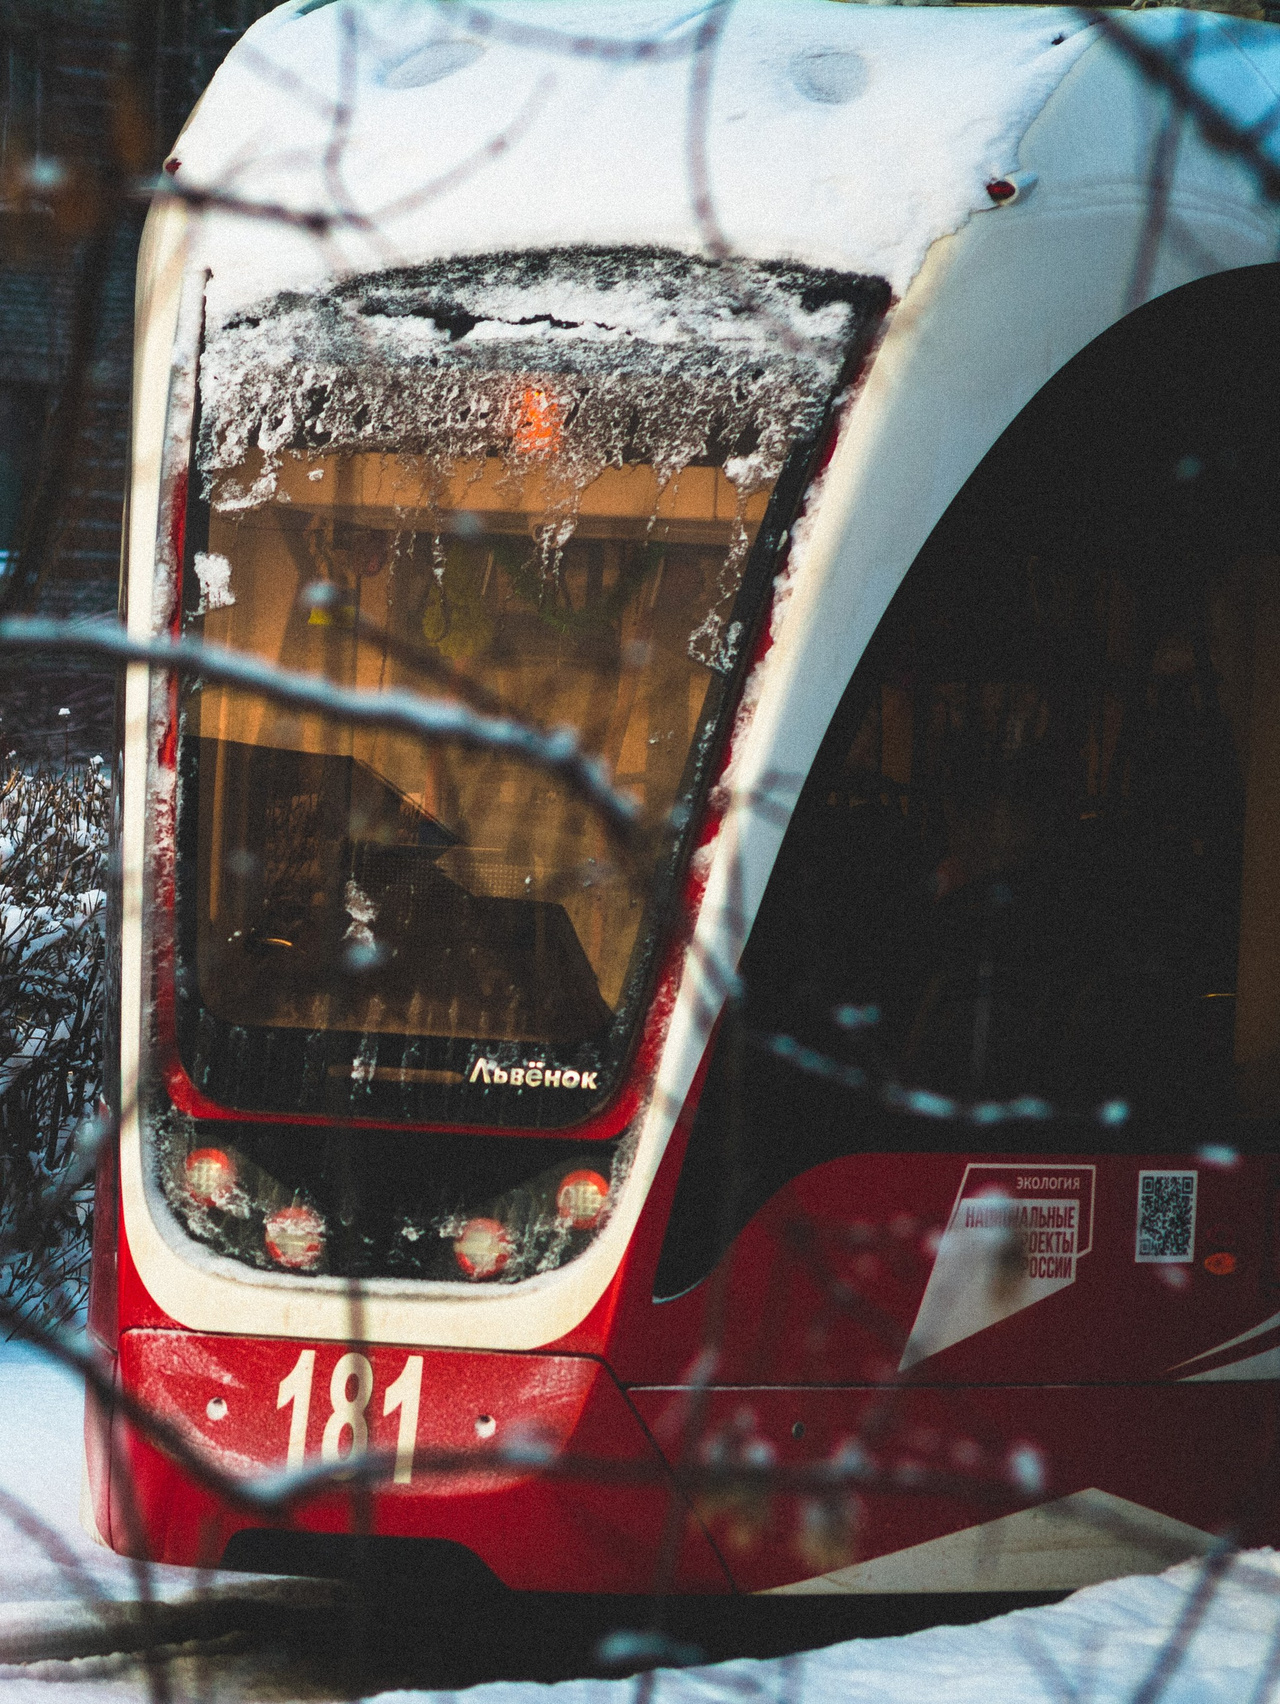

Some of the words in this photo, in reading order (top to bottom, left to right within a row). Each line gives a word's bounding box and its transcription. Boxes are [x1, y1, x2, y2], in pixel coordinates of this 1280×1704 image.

[469, 1057, 598, 1090] Львёнок
[1016, 1176, 1080, 1190] ЭКОЛОГИЯ
[965, 1205, 1075, 1229] НААЛЬНЫЕ
[1013, 1230, 1074, 1254] ОЕКТЫ
[1020, 1255, 1072, 1279] ОССИИ
[276, 1349, 424, 1484] 181
